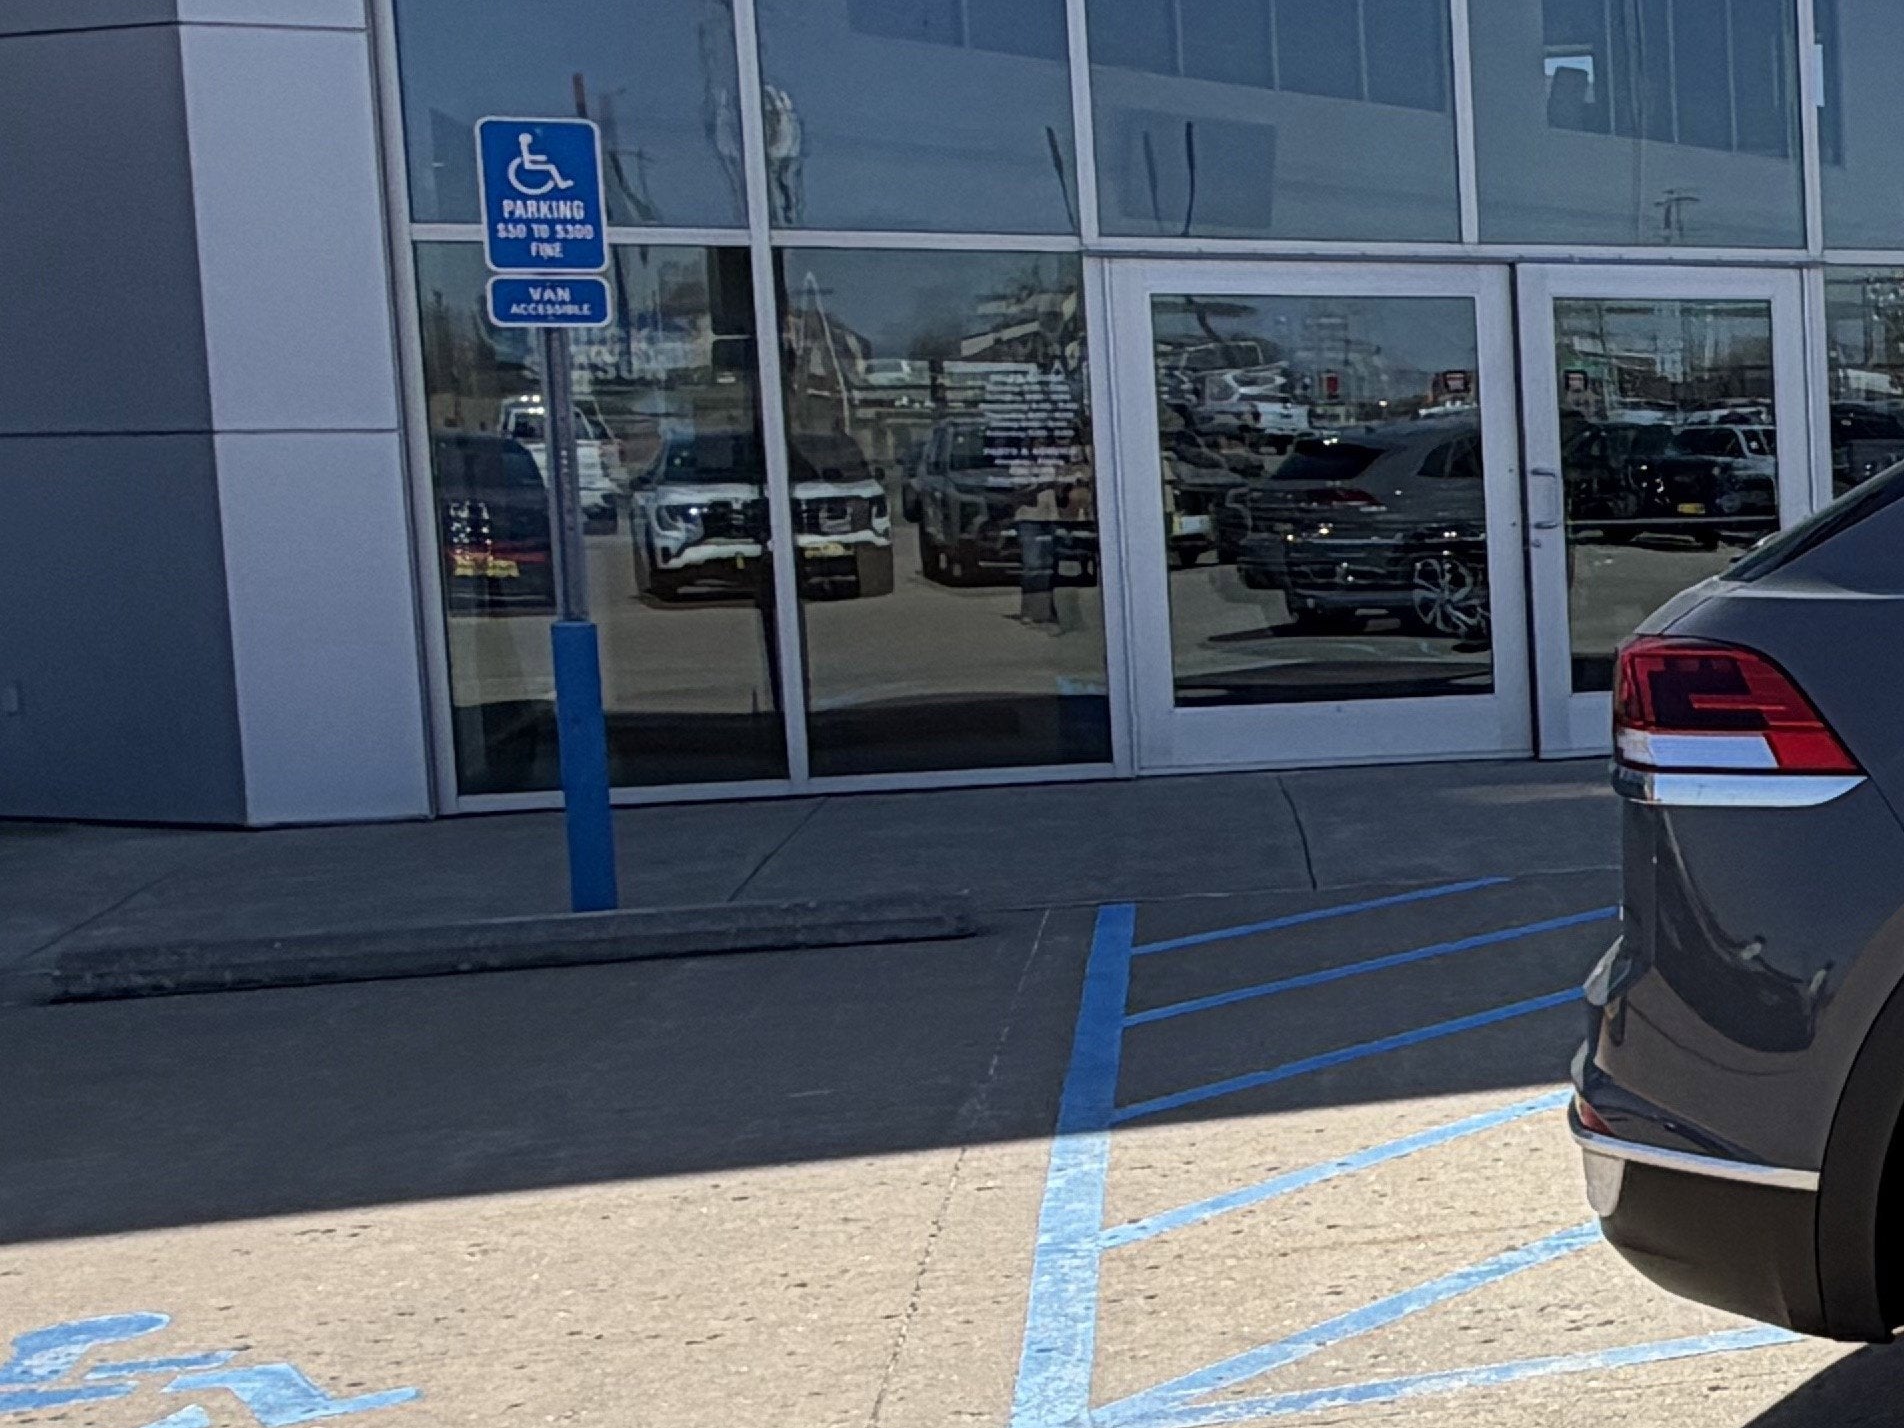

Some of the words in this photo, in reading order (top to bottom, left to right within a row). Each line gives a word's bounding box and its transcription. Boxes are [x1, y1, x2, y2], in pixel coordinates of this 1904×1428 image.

[502, 199, 585, 220] PARKING
[497, 223, 527, 239] $50
[531, 224, 550, 239] TO
[555, 224, 595, 240] $300
[530, 242, 564, 258] FINE
[528, 286, 571, 302] VAN
[510, 303, 592, 316] ACCESSIBLE
